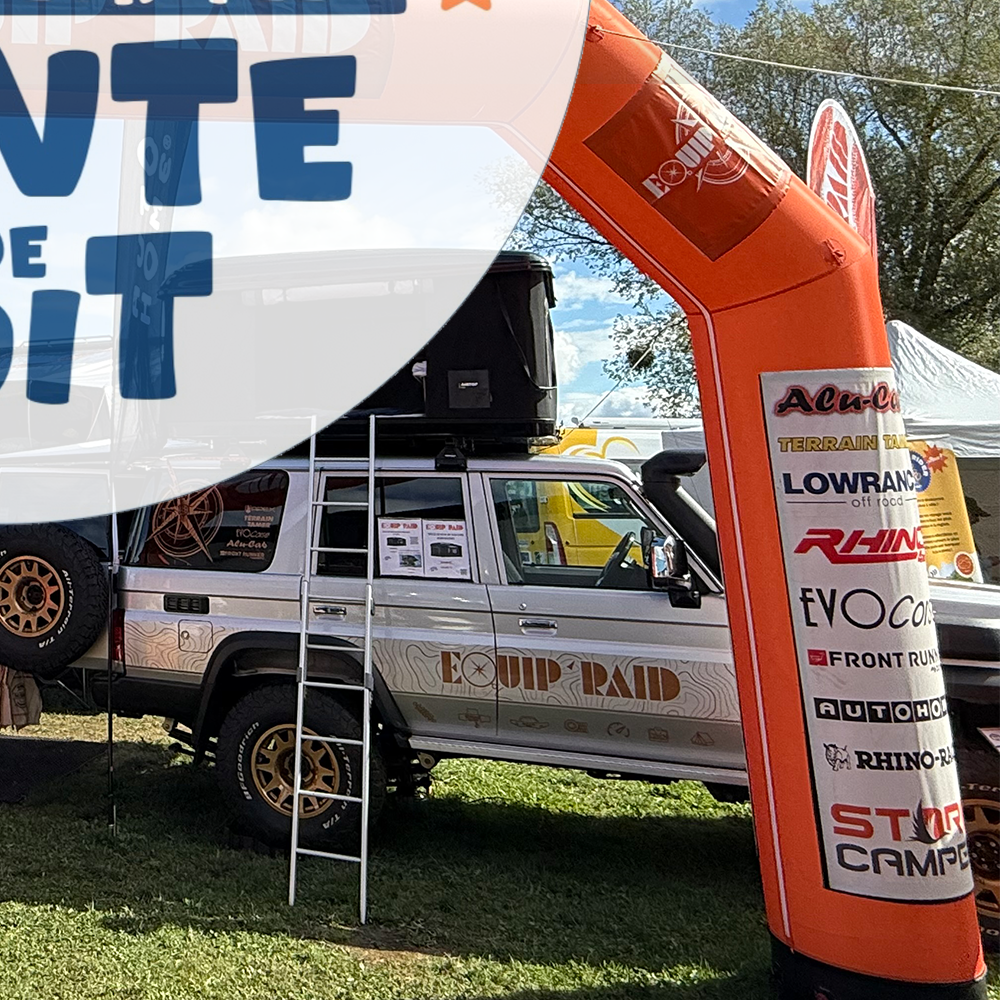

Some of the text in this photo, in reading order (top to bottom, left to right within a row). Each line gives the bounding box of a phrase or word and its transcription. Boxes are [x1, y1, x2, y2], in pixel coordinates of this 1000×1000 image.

[775, 382, 900, 416] Alu-Ca
[777, 435, 878, 453] TERRAIN
[782, 470, 916, 495] LOWRANC
[851, 495, 872, 508] off
[61, 569, 75, 635] All-Terrain
[799, 588, 936, 630] EVOCor
[38, 637, 56, 649] T/A
[828, 651, 942, 669] FRONT RUNN
[813, 692, 948, 723] AUTOHO
[236, 721, 260, 801] BFGoodrich
[854, 745, 956, 771] RHINO-RA
[322, 813, 341, 830] T/A
[831, 798, 966, 843] STOR
[835, 842, 970, 877] CAMPE
